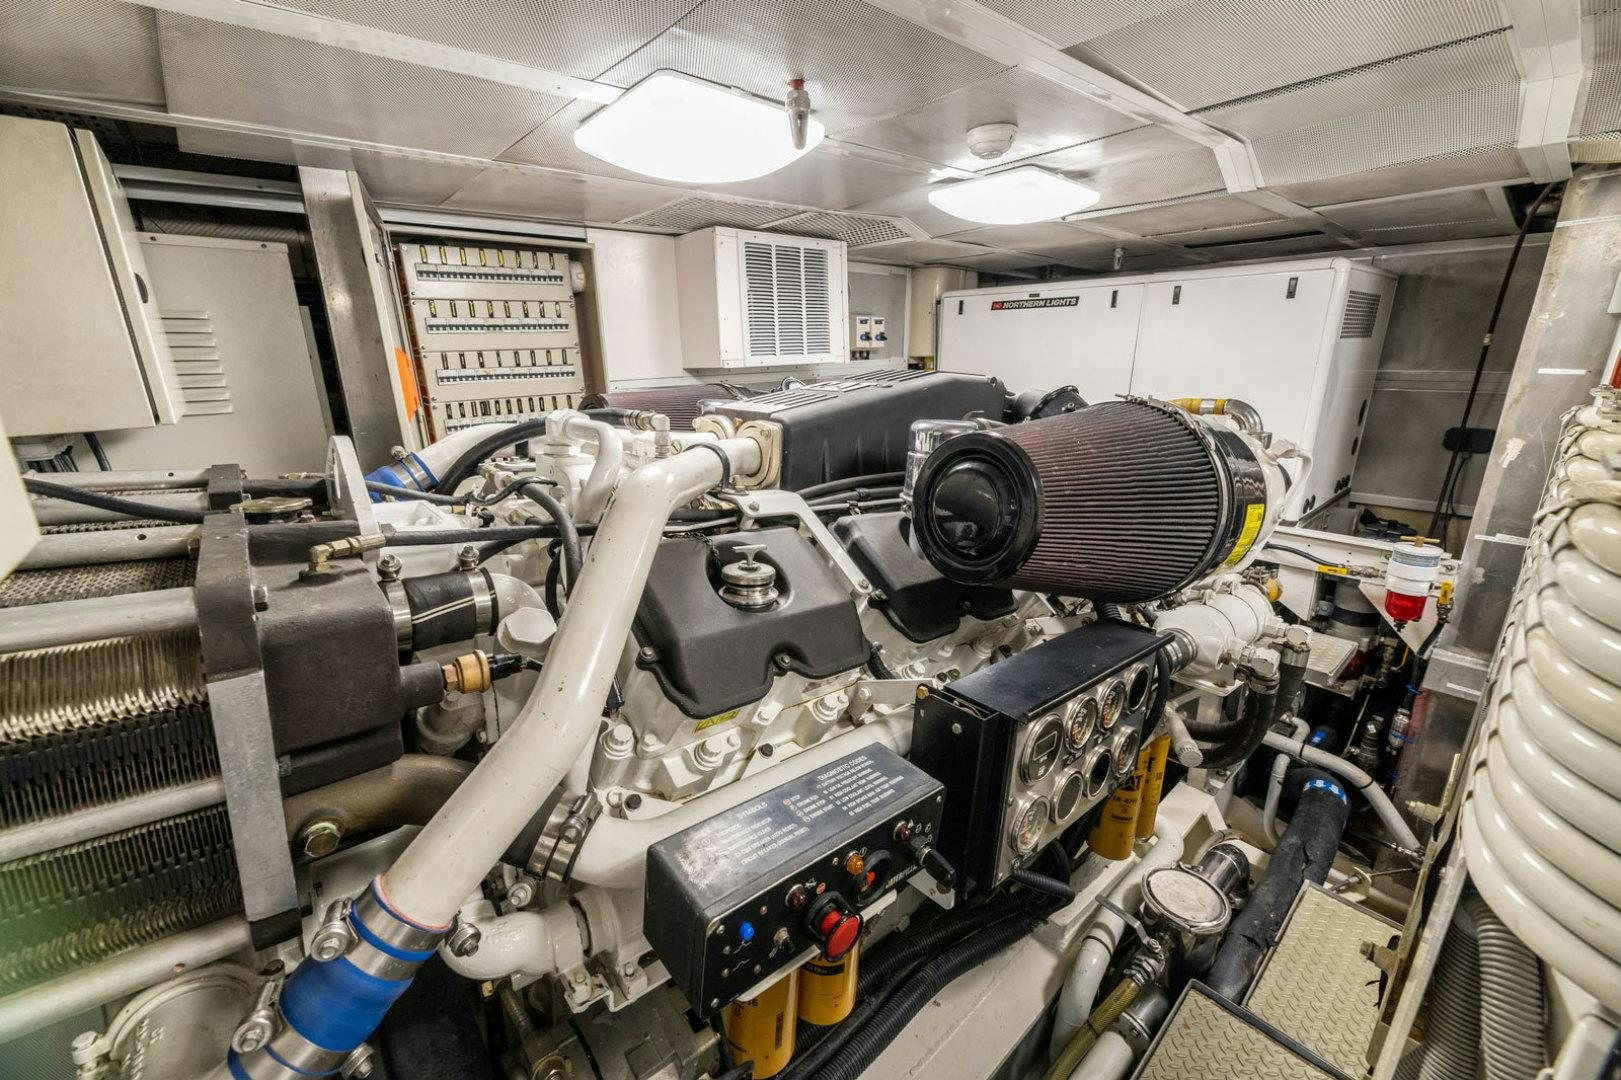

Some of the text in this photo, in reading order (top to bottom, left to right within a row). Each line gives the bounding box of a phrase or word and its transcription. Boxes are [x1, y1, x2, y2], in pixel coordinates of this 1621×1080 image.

[1002, 298, 1077, 309] NORTHERN LIGHTS
[818, 755, 868, 780] DIAGNOSTIC CODES
